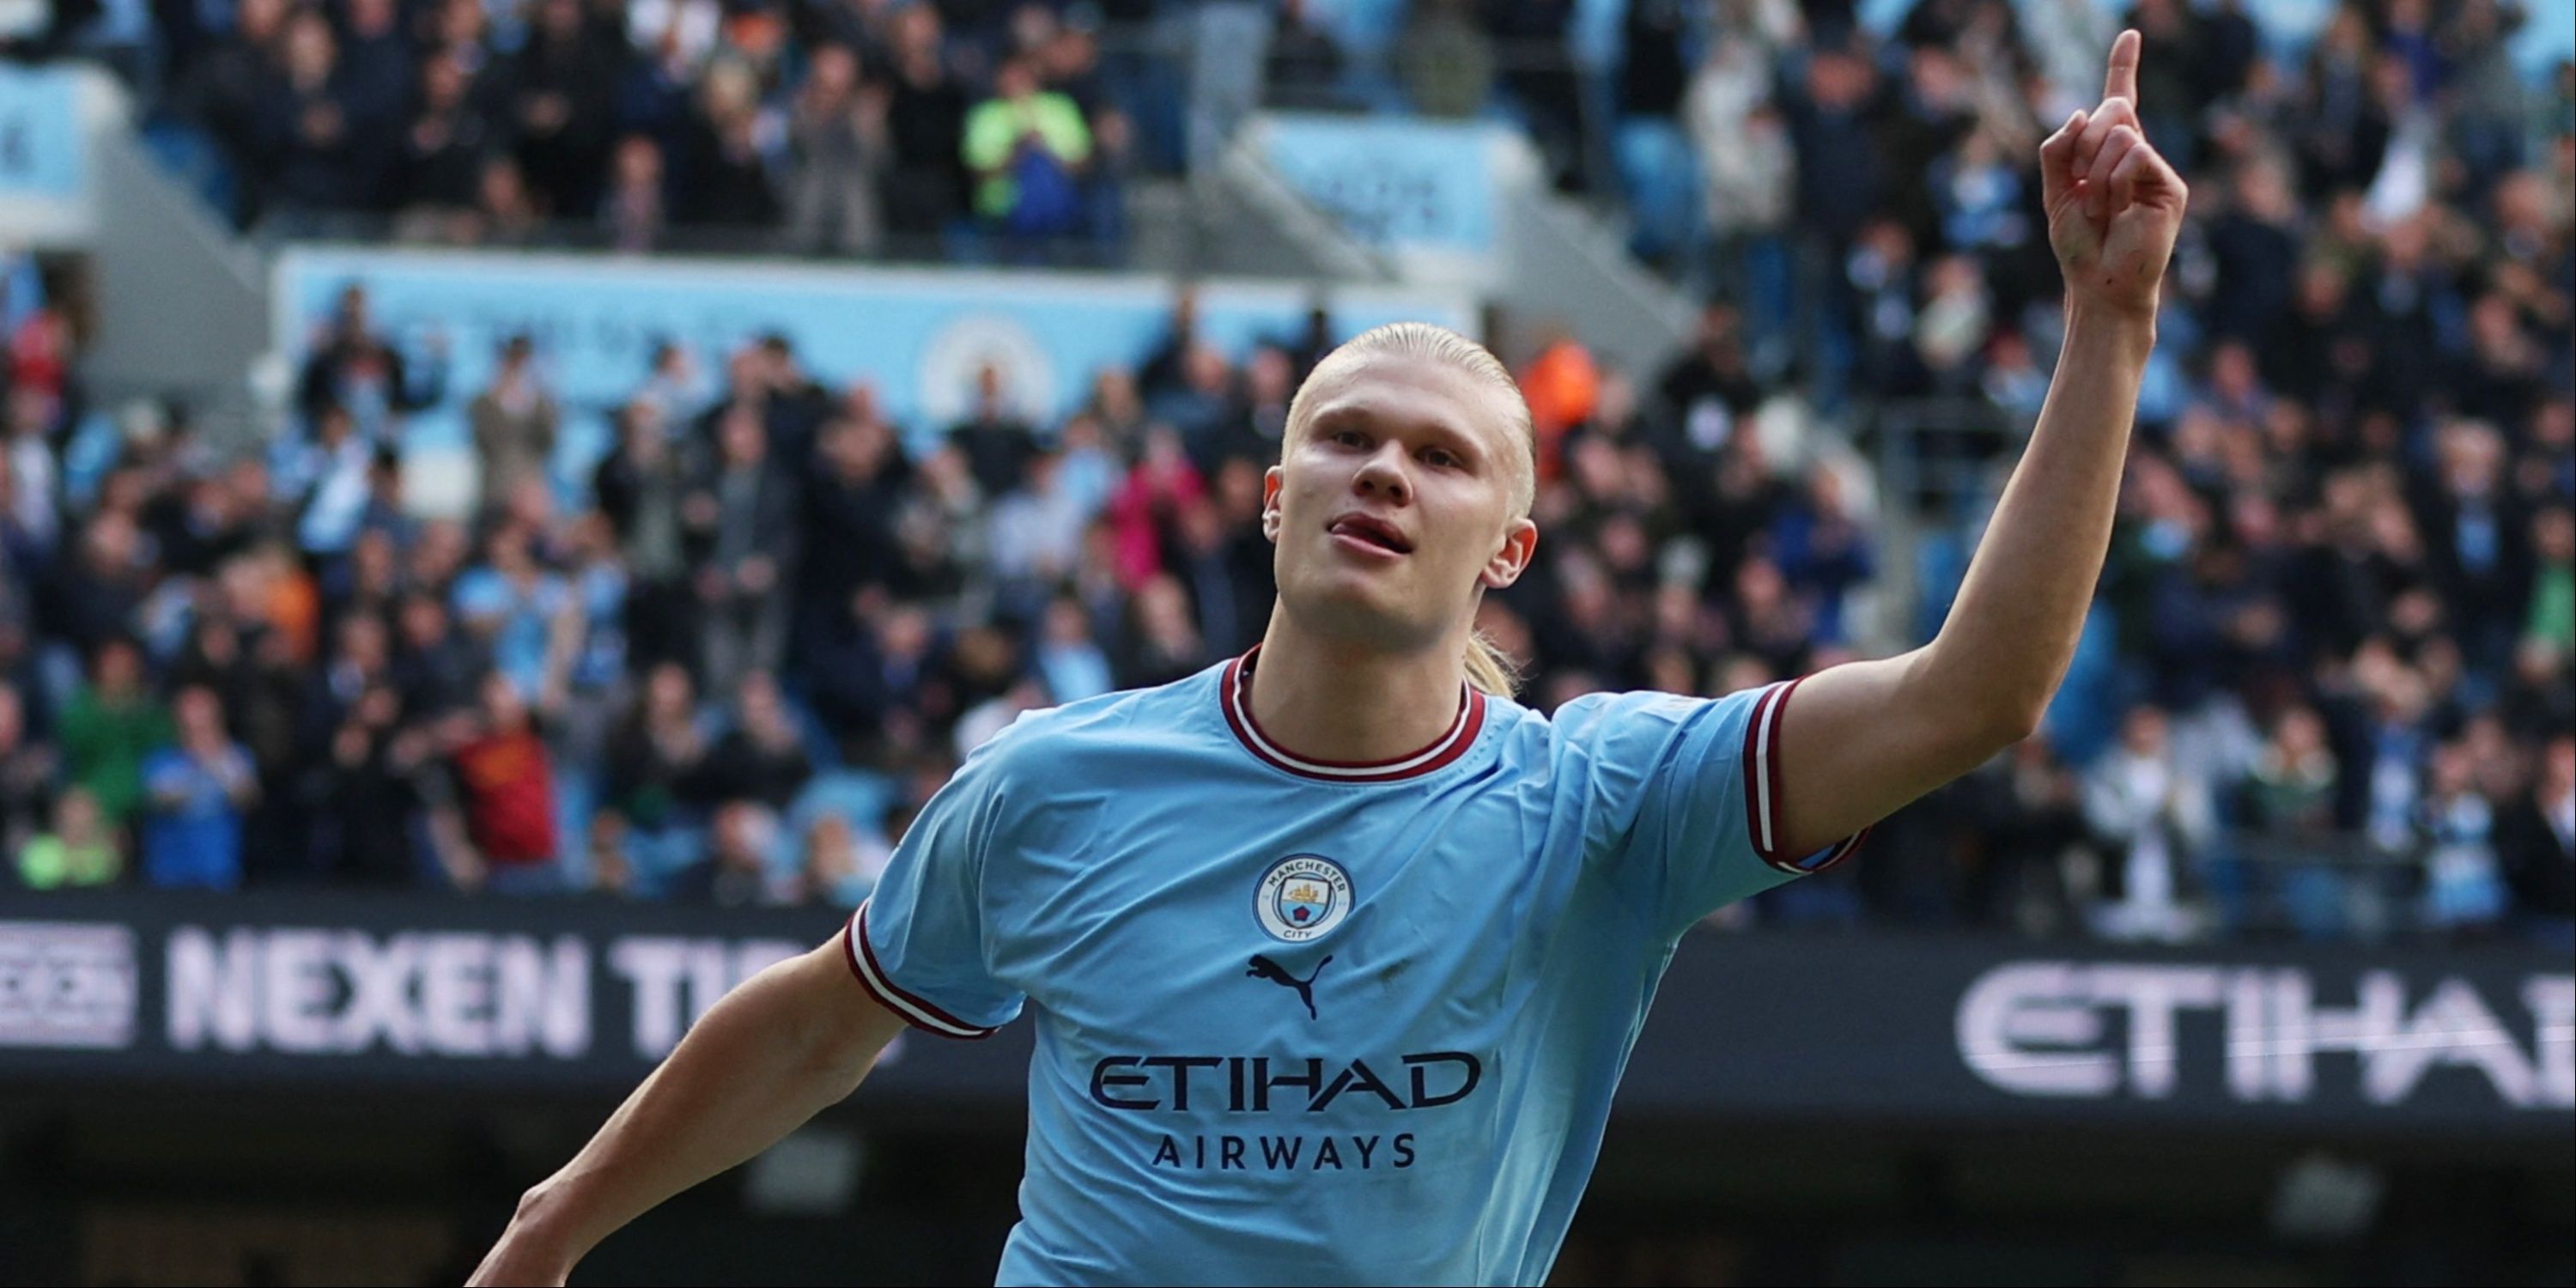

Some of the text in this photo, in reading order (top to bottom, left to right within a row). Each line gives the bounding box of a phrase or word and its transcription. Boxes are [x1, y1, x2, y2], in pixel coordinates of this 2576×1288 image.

[1268, 861, 1346, 892] MANCHESTER
[1284, 930, 1312, 939] CITY
[168, 926, 592, 1059] NEXEN
[1090, 1050, 1481, 1111] ETIHAD
[1151, 1133, 1415, 1170] AIRWAYS
